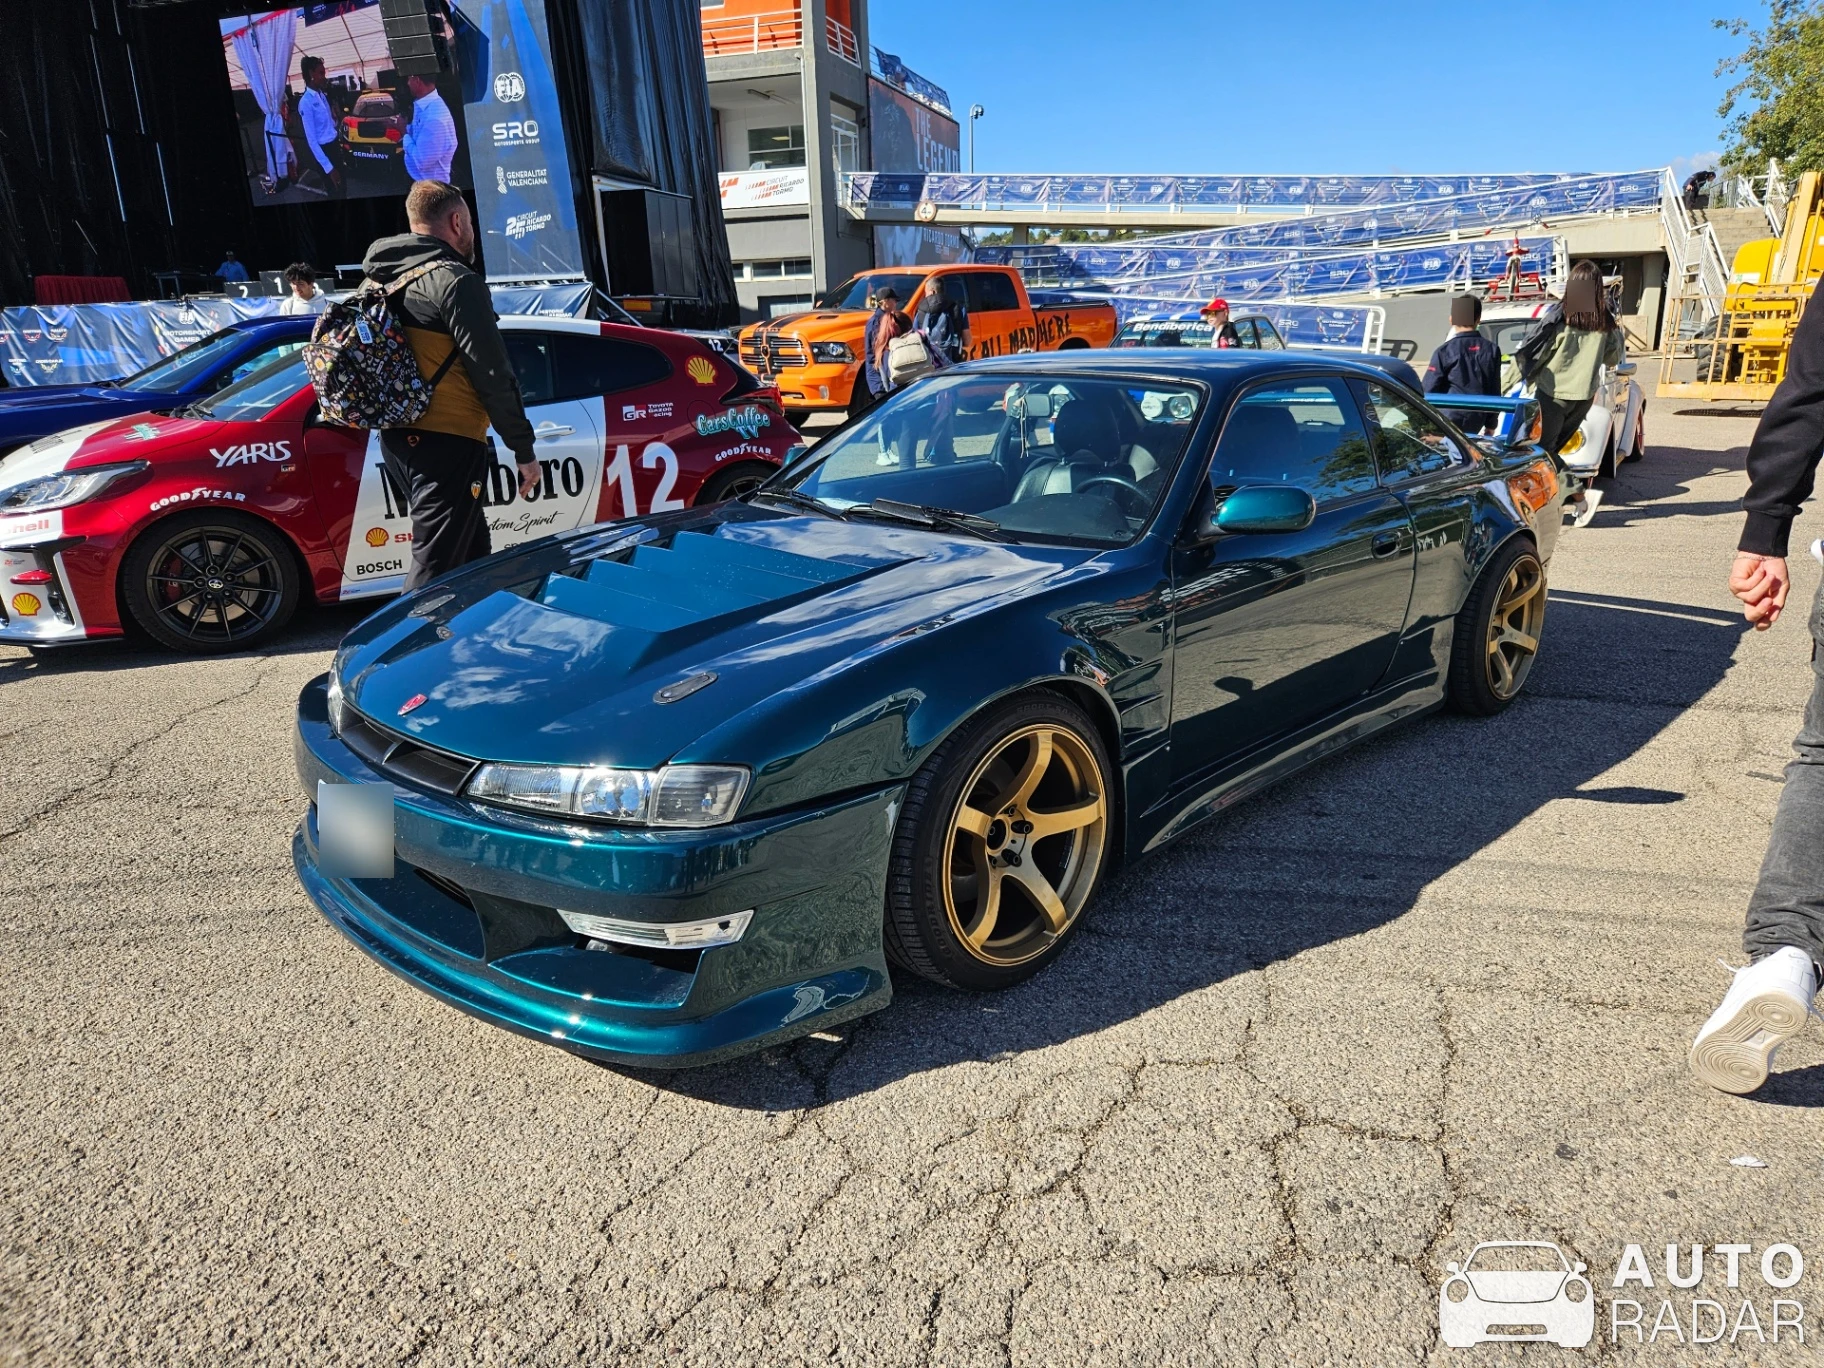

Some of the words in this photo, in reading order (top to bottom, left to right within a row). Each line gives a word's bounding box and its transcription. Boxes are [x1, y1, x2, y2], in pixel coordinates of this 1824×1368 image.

[493, 120, 539, 139] SRO
[915, 107, 932, 138] THE
[917, 133, 960, 173] LEGEND
[507, 169, 547, 178] GENERALITAT
[508, 178, 548, 186] VALENCIANA
[780, 178, 804, 188] RICARDO
[773, 187, 794, 196] TORMO
[517, 211, 537, 221] CIRCUIT
[526, 214, 551, 226] RICARDO
[525, 223, 545, 233] TORMO
[923, 227, 944, 246] RICARDO
[238, 285, 248, 299] 2
[274, 276, 283, 294] 1
[1009, 326, 1036, 354] MAD
[1038, 313, 1072, 347] HERE
[1133, 322, 1213, 332] Bendiberica
[708, 338, 723, 352] 12
[735, 424, 759, 439] TV
[715, 443, 772, 461] GOODYEAR
[606, 441, 684, 518] 12
[150, 487, 246, 511] GOODYEAR
[8, 519, 49, 534] hell
[513, 510, 565, 535] Spirit
[356, 559, 403, 576] BOSCH
